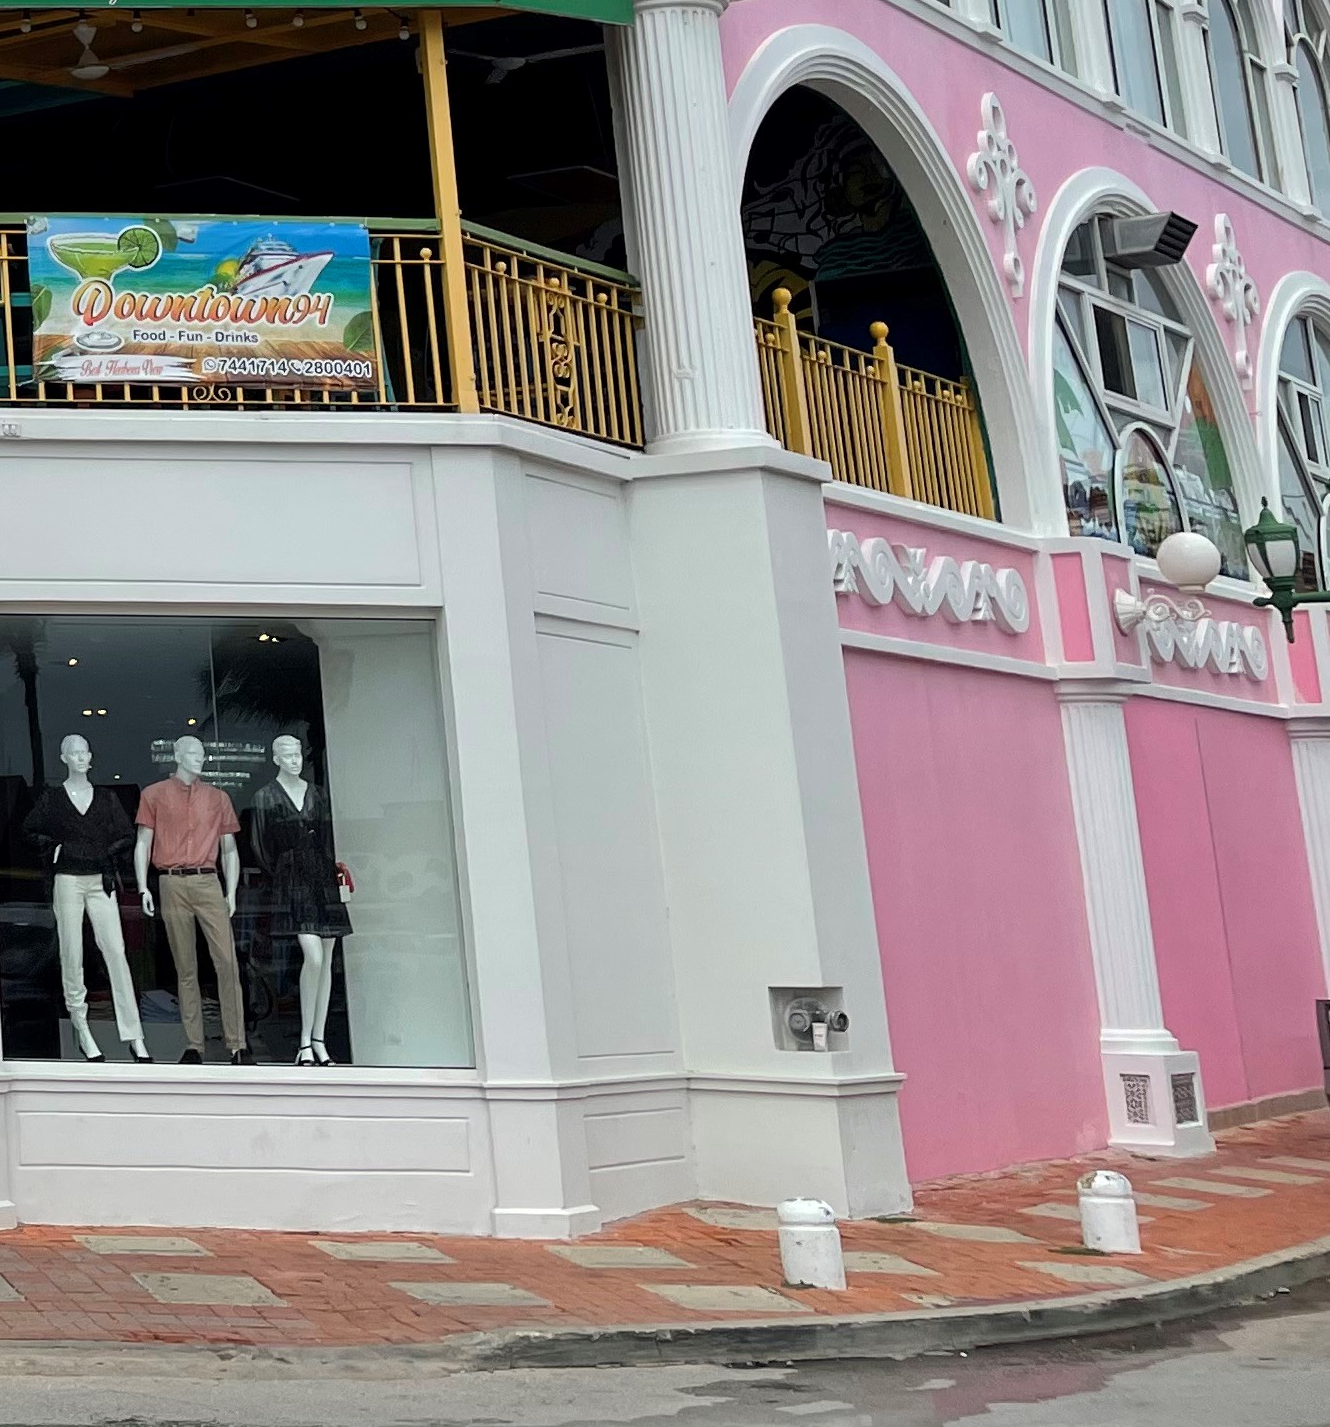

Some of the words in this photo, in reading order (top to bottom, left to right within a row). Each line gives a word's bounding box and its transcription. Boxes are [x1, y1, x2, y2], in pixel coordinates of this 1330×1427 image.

[72, 280, 333, 326] Downtown94
[132, 330, 168, 342] Food
[179, 330, 203, 342] Fun
[215, 331, 259, 344] Drinks
[219, 358, 287, 374] 7441714
[305, 361, 371, 376] 2800401
